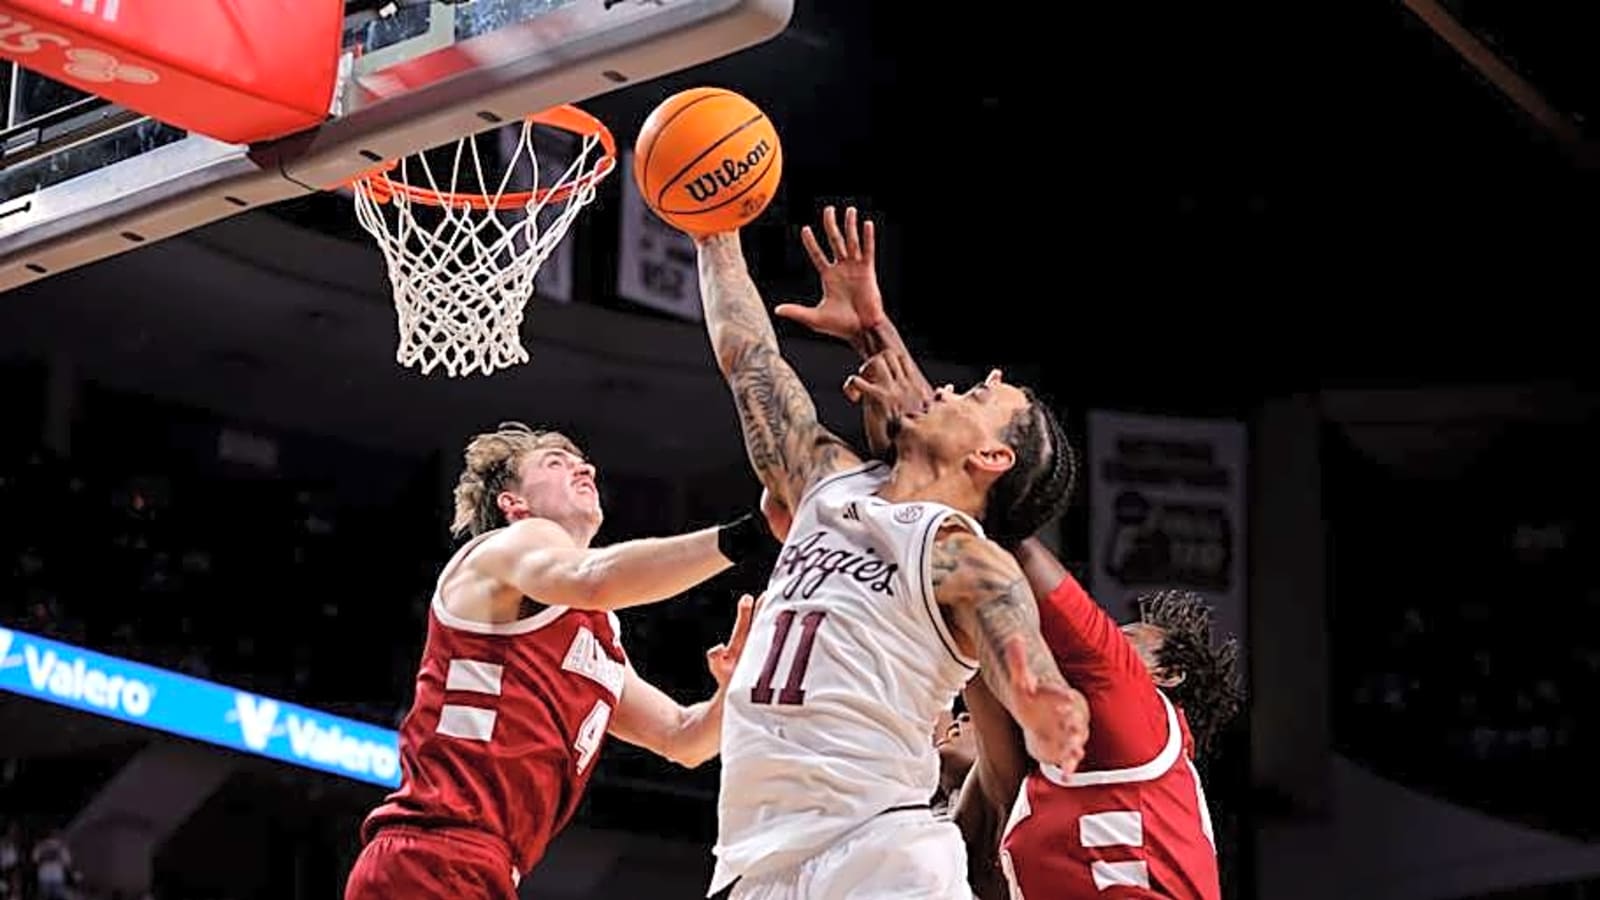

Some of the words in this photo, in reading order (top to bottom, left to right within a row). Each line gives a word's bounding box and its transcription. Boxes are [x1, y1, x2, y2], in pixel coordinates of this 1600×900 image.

[684, 139, 770, 202] Wilson
[780, 531, 899, 600] Aggies
[25, 645, 153, 717] Valero
[751, 610, 827, 706] 11
[287, 713, 399, 779] Valero
